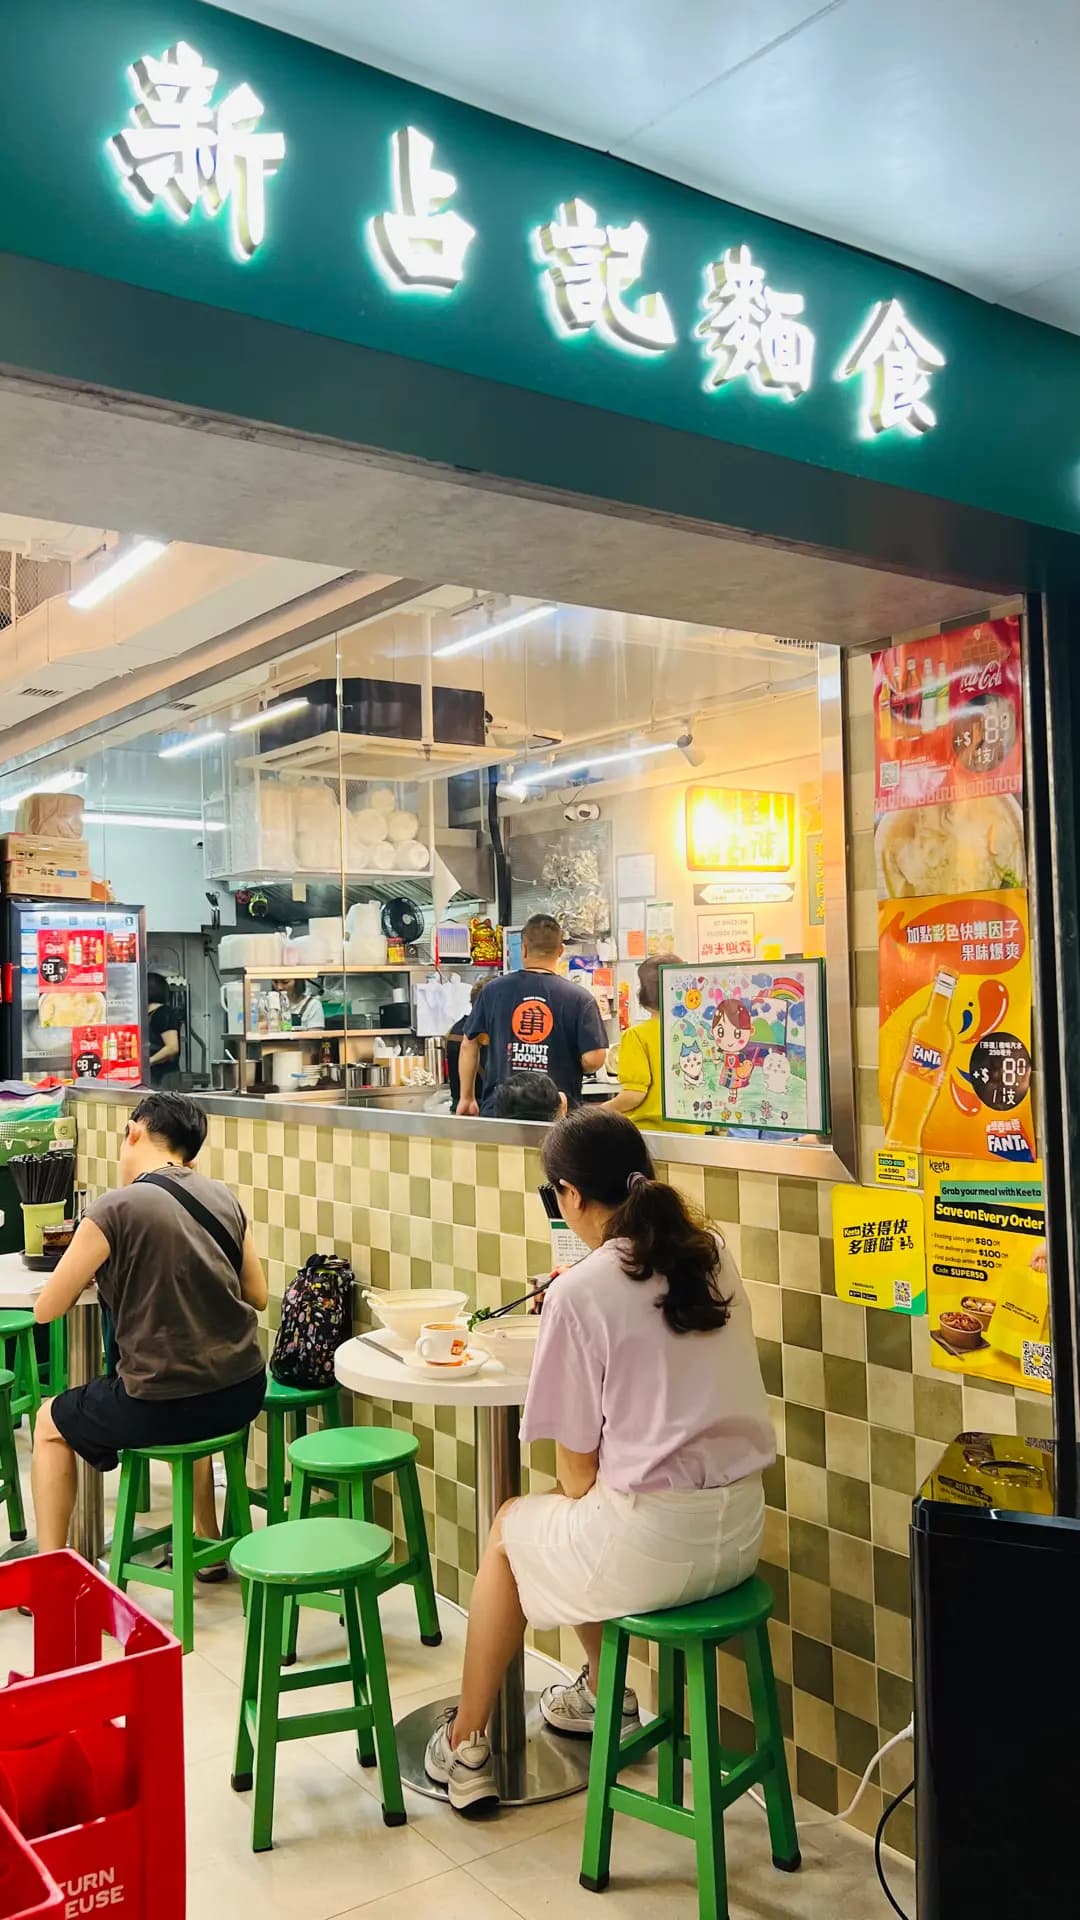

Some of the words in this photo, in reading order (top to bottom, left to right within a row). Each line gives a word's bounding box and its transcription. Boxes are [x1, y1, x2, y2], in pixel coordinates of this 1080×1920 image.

[107, 40, 947, 438] 新占記麵食
[906, 919, 1020, 944] 加點彩色快樂因子
[961, 942, 1020, 961] 果味爆爽
[912, 1044, 942, 1066] FANTA
[987, 1134, 1030, 1152] FANTA
[942, 1187, 960, 1195] Grab
[960, 1188, 977, 1197] your
[978, 1187, 997, 1196] meal
[998, 1187, 1015, 1196] with
[1016, 1188, 1042, 1197] Keeta
[935, 1203, 963, 1218] Save
[963, 1209, 977, 1220] on
[977, 1209, 1009, 1227] Every
[1009, 1213, 1044, 1230] Order
[862, 1218, 908, 1238] 送得快
[975, 1237, 993, 1247] $80
[978, 1249, 1001, 1259] $100
[976, 1259, 995, 1269] $50
